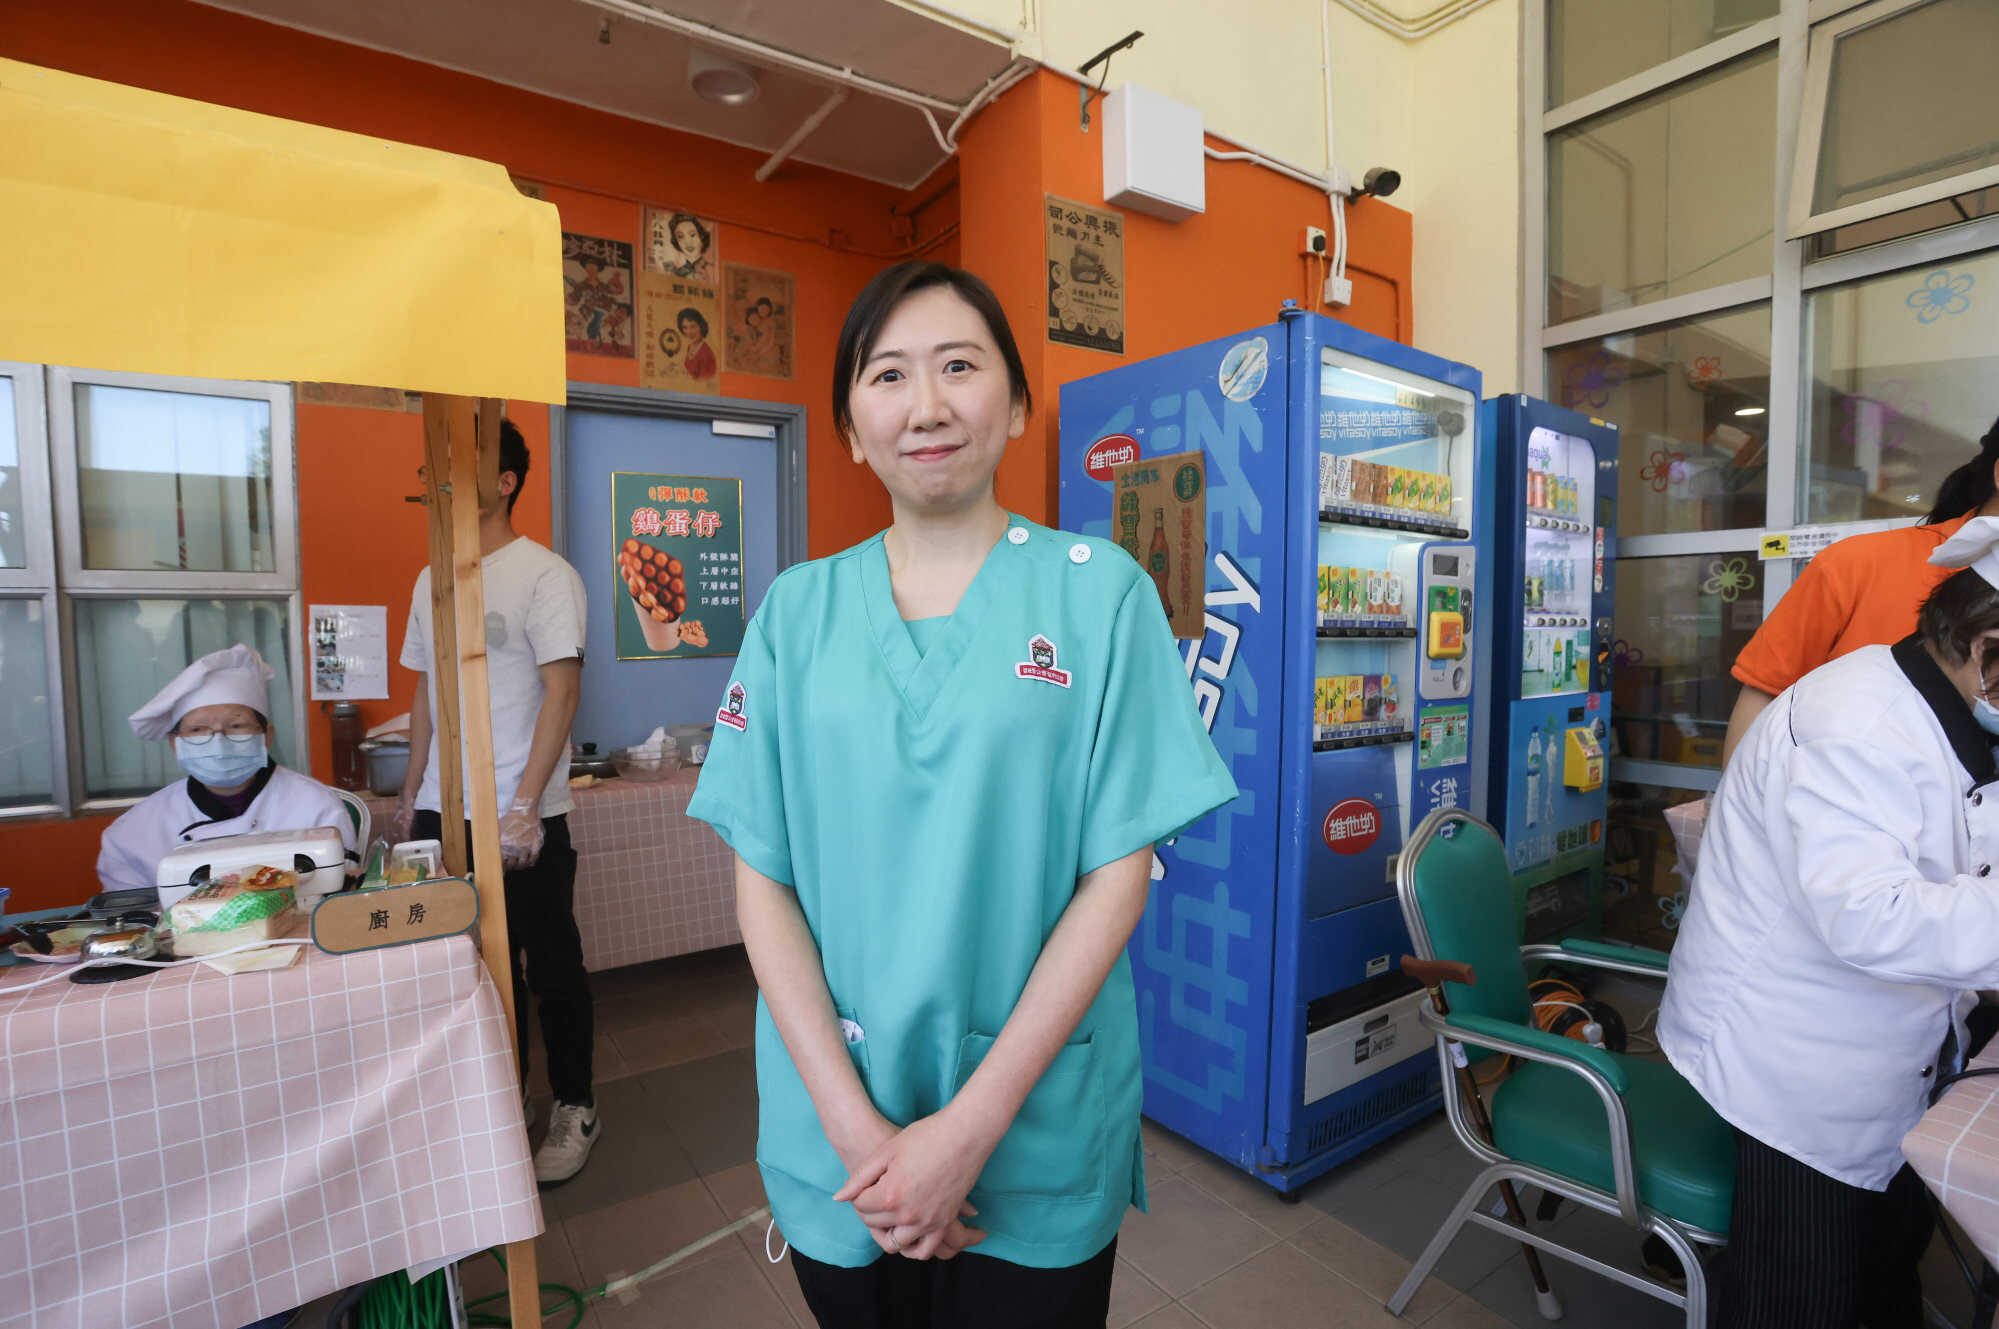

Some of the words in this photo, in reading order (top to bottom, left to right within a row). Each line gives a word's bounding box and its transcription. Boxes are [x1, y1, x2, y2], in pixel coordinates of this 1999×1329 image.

[1090, 445, 1134, 470] 維他奶
[1329, 812, 1376, 841] 維他奶
[368, 902, 427, 931] 廚房
